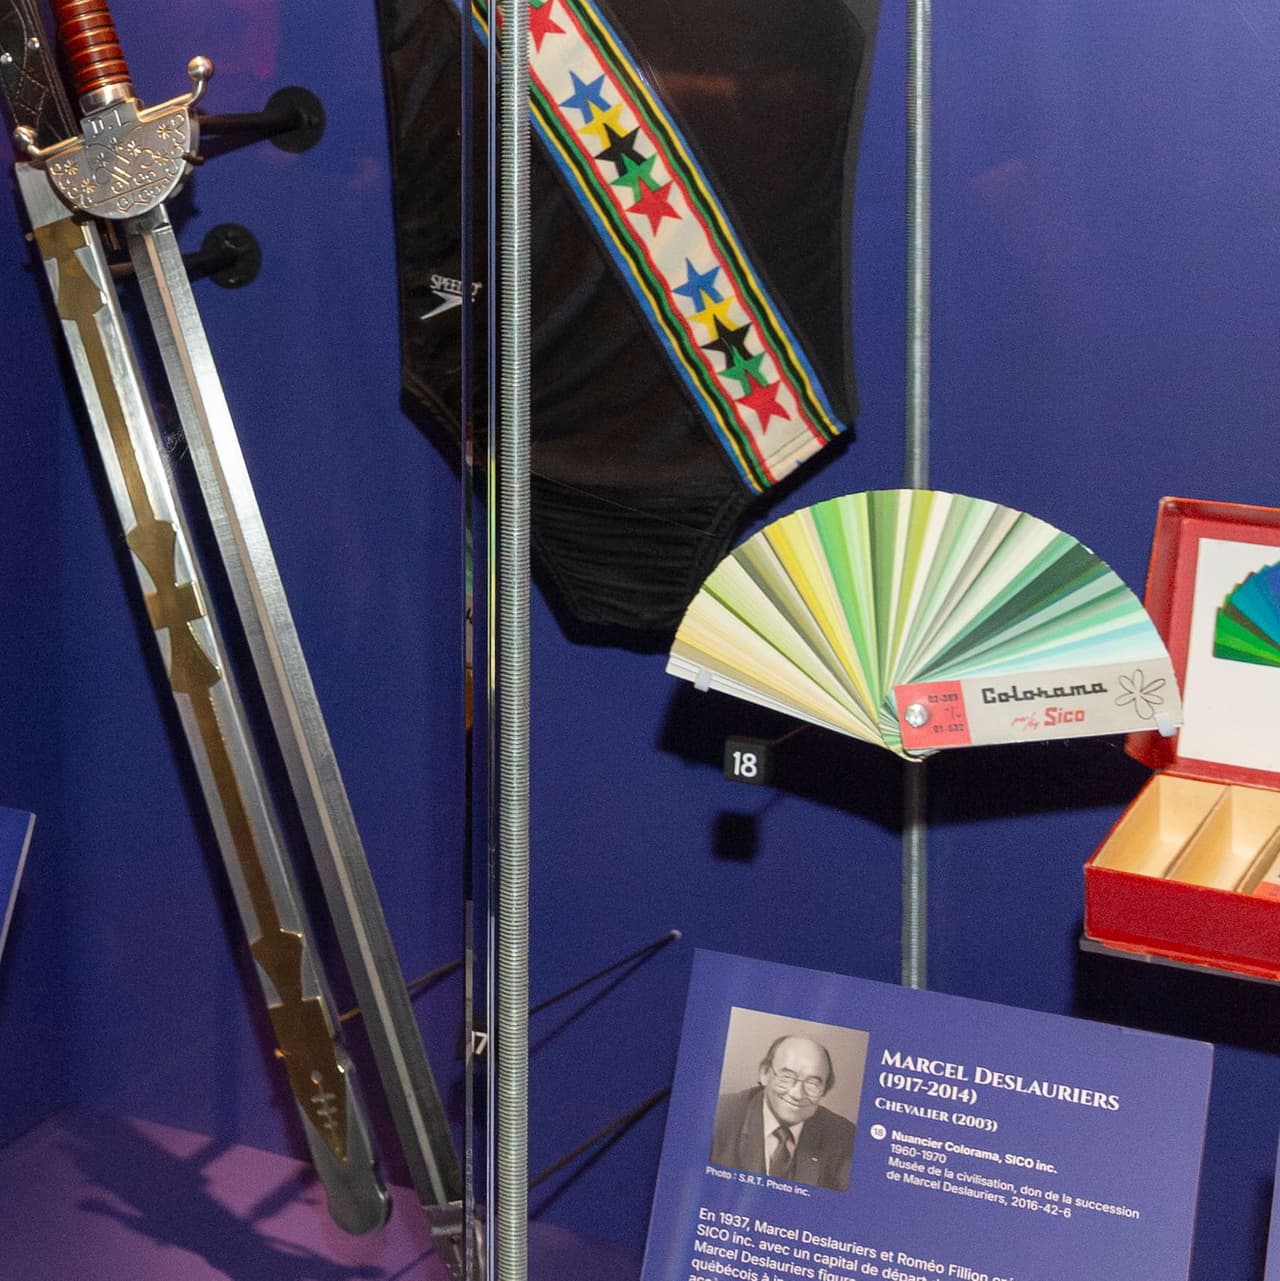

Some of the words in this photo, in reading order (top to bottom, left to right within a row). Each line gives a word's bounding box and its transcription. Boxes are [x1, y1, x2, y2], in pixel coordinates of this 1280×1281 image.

[981, 682, 1108, 704] Colorama
[1044, 707, 1085, 726] Sico
[733, 751, 758, 778] 18
[879, 1072, 977, 1105] (1917-2014)
[882, 1049, 968, 1080] MARCEL
[974, 1067, 1119, 1111] DESLAURIERS
[875, 1097, 949, 1122] CHEVALIER
[952, 1113, 998, 1132] (2003)
[891, 1130, 943, 1149] Nuancier
[944, 1141, 1002, 1164] Colorama,
[1005, 1154, 1034, 1168] SICO
[1035, 1159, 1056, 1173] inc.
[891, 1143, 947, 1164] 1960-1970
[706, 1166, 732, 1180] Photo
[738, 1173, 764, 1187] S.R.T.
[766, 1179, 793, 1193] Photo
[794, 1185, 810, 1197] inc.
[886, 1170, 901, 1181] de
[903, 1173, 941, 1190] Marcel
[942, 1181, 1007, 1206] Deslauriers,
[1011, 1196, 1071, 1218] 2016-42-6
[888, 1156, 925, 1173] Musée
[927, 1166, 942, 1176] de
[944, 1168, 954, 1179] la
[956, 1171, 1016, 1194] civilisation,
[1020, 1185, 1042, 1198] don
[1044, 1190, 1059, 1202] de
[1062, 1193, 1072, 1204] la
[1075, 1198, 1140, 1219] succession
[694, 1239, 739, 1260] Marcel
[741, 1250, 815, 1278] Deslauriers
[697, 1224, 730, 1241] SICO
[732, 1231, 754, 1248] inc.
[759, 1240, 790, 1255] avec
[793, 1248, 810, 1260] un
[813, 1253, 858, 1271] capital
[861, 1262, 878, 1276] de
[699, 1207, 716, 1222] En
[720, 1212, 750, 1232] 1937,
[754, 1220, 799, 1241] Marcel
[802, 1231, 877, 1258] Deslauriers
[880, 1251, 894, 1263] et
[897, 1252, 945, 1274] Roméo
[948, 1264, 988, 1281] Fillion
[691, 1258, 758, 1281] québécois
[761, 1272, 770, 1281] à
